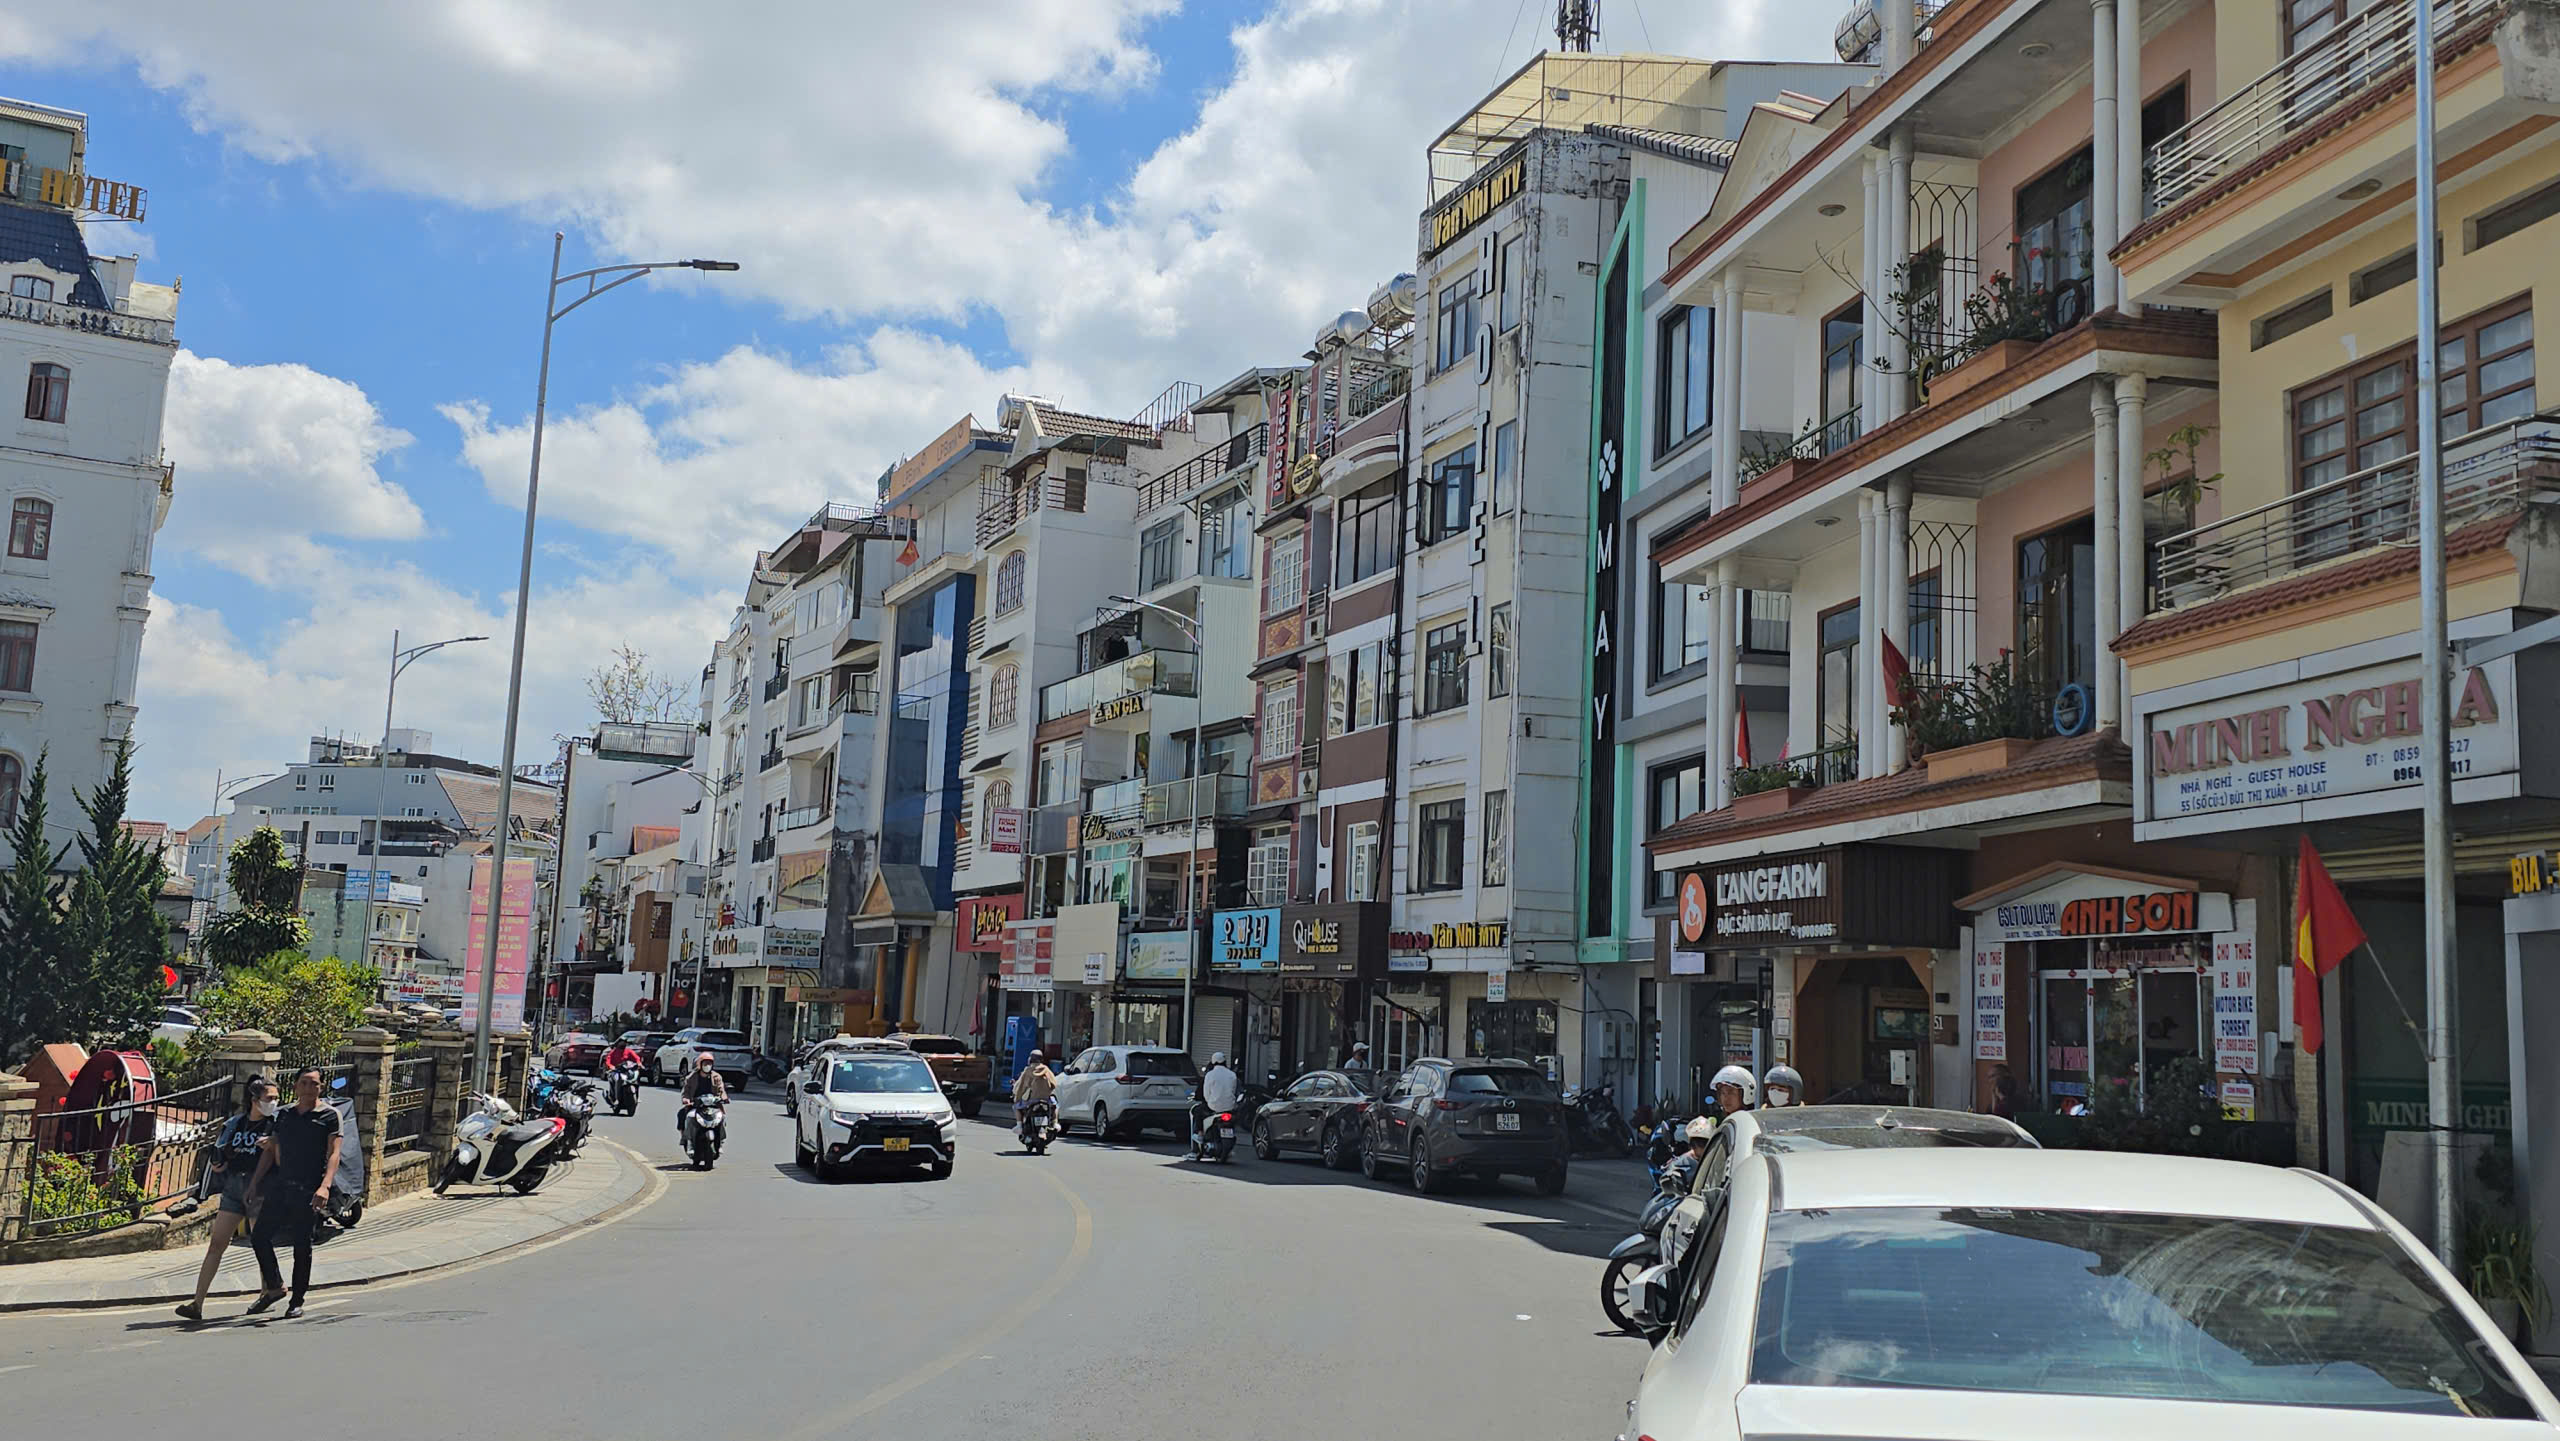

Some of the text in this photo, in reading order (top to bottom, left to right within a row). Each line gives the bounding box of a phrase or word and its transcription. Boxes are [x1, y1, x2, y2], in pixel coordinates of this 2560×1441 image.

[40, 167, 148, 223] HOTEL
[1491, 159, 1523, 210] MTV
[1464, 230, 1497, 658] HOTEL
[2152, 665, 2499, 778] MINH NGHA
[2393, 746, 2421, 763] 0859
[2248, 767, 2284, 785] GUEST
[2288, 761, 2328, 779] HOUSE
[2393, 765, 2422, 782] 0964
[1716, 861, 1827, 907] L'ANGFARM
[2511, 855, 2541, 895] BIA
[2020, 904, 2034, 927] DU
[2060, 892, 2197, 936] ANH SON
[1478, 926, 1501, 948] MTV
[2216, 938, 2252, 961] CHO THUÊ
[2221, 971, 2229, 989] XE
